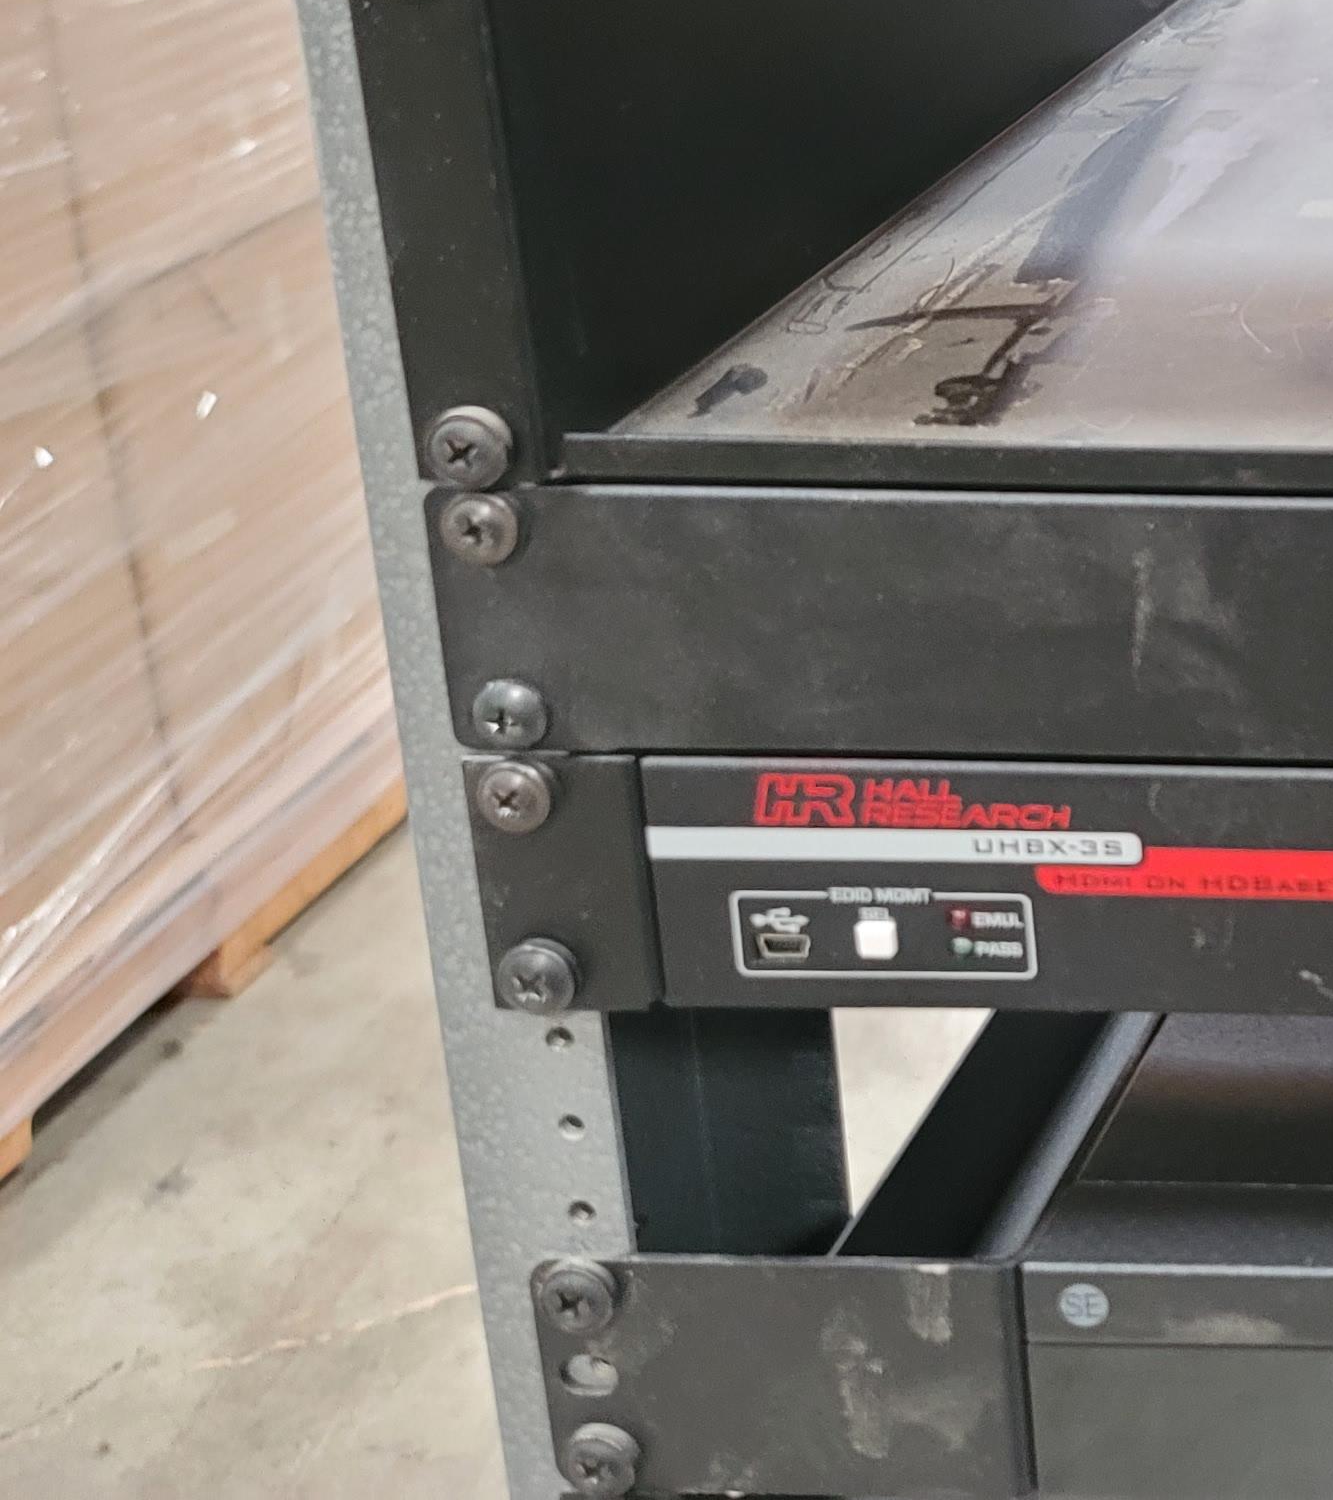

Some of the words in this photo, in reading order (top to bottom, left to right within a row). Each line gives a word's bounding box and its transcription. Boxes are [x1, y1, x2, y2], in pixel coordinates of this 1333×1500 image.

[864, 779, 952, 802] HALL
[861, 799, 1071, 830] RESEARCH
[972, 838, 1124, 856] UHBX-3S
